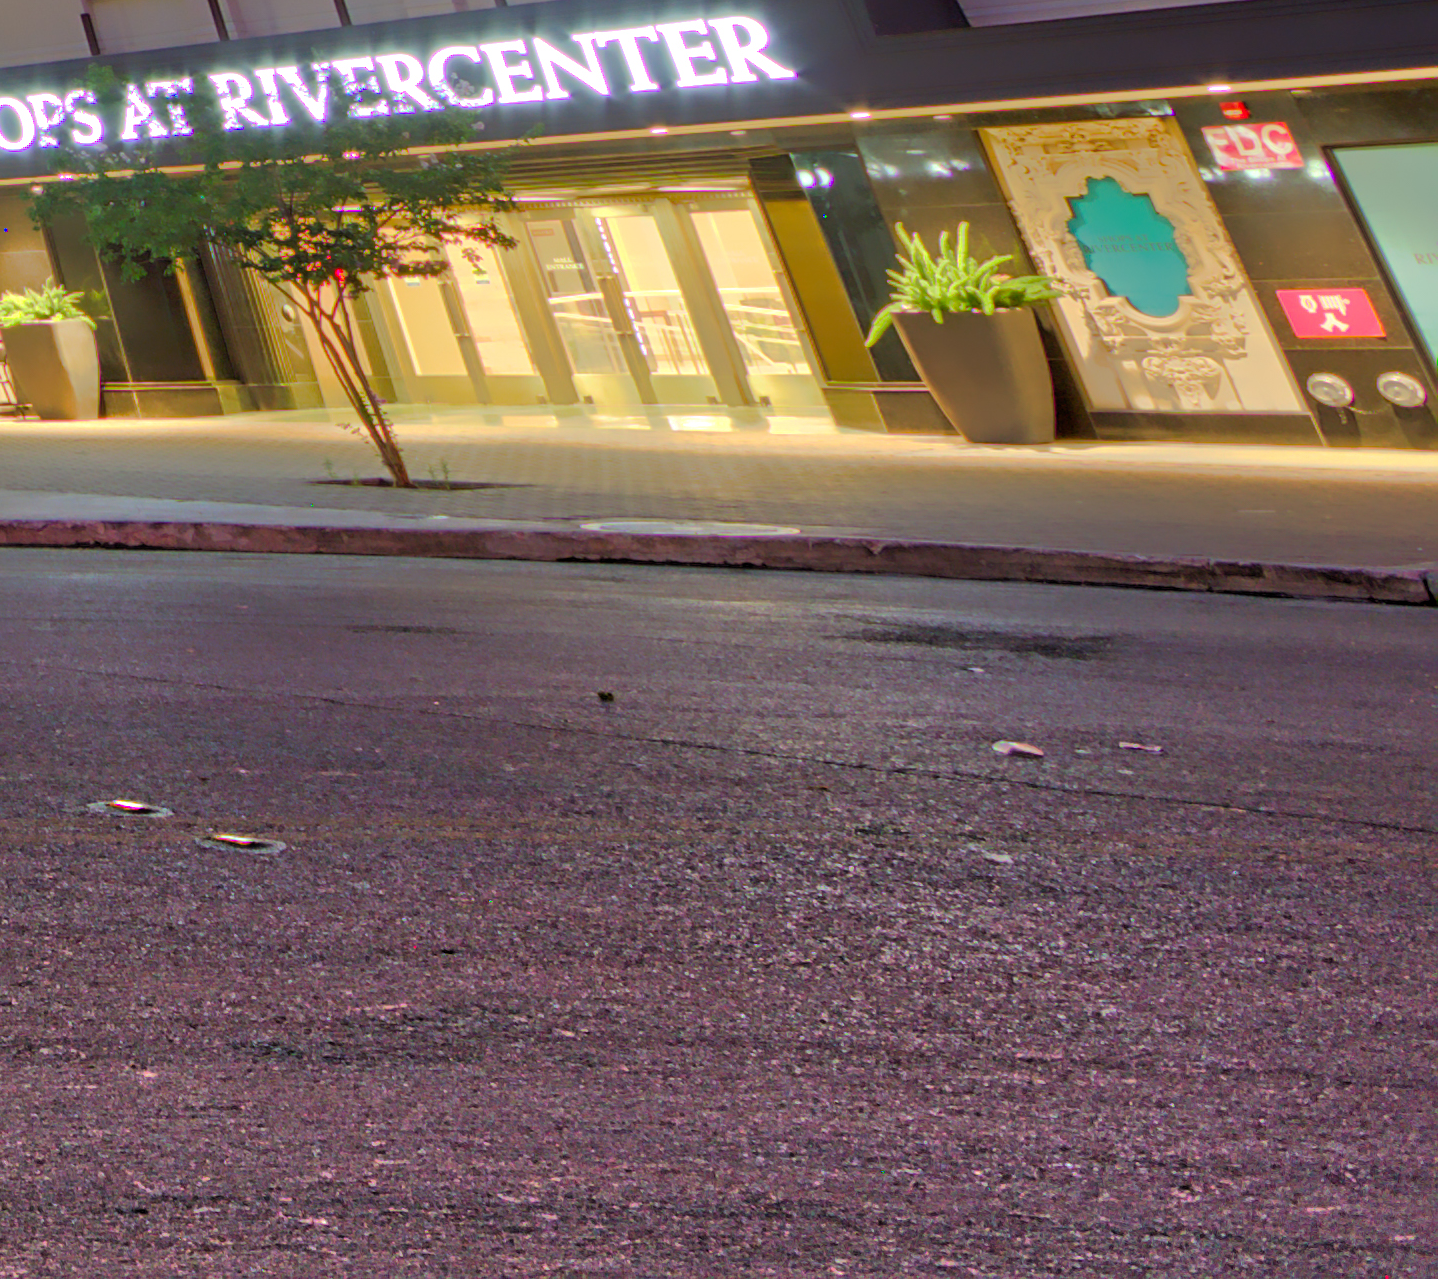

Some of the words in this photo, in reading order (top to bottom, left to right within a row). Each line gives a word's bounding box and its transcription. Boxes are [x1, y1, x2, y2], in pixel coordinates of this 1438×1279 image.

[121, 76, 194, 142] AT
[208, 15, 798, 132] RIVERCENTER
[1204, 124, 1293, 166] FDC
[1098, 235, 1134, 243] SHOPS
